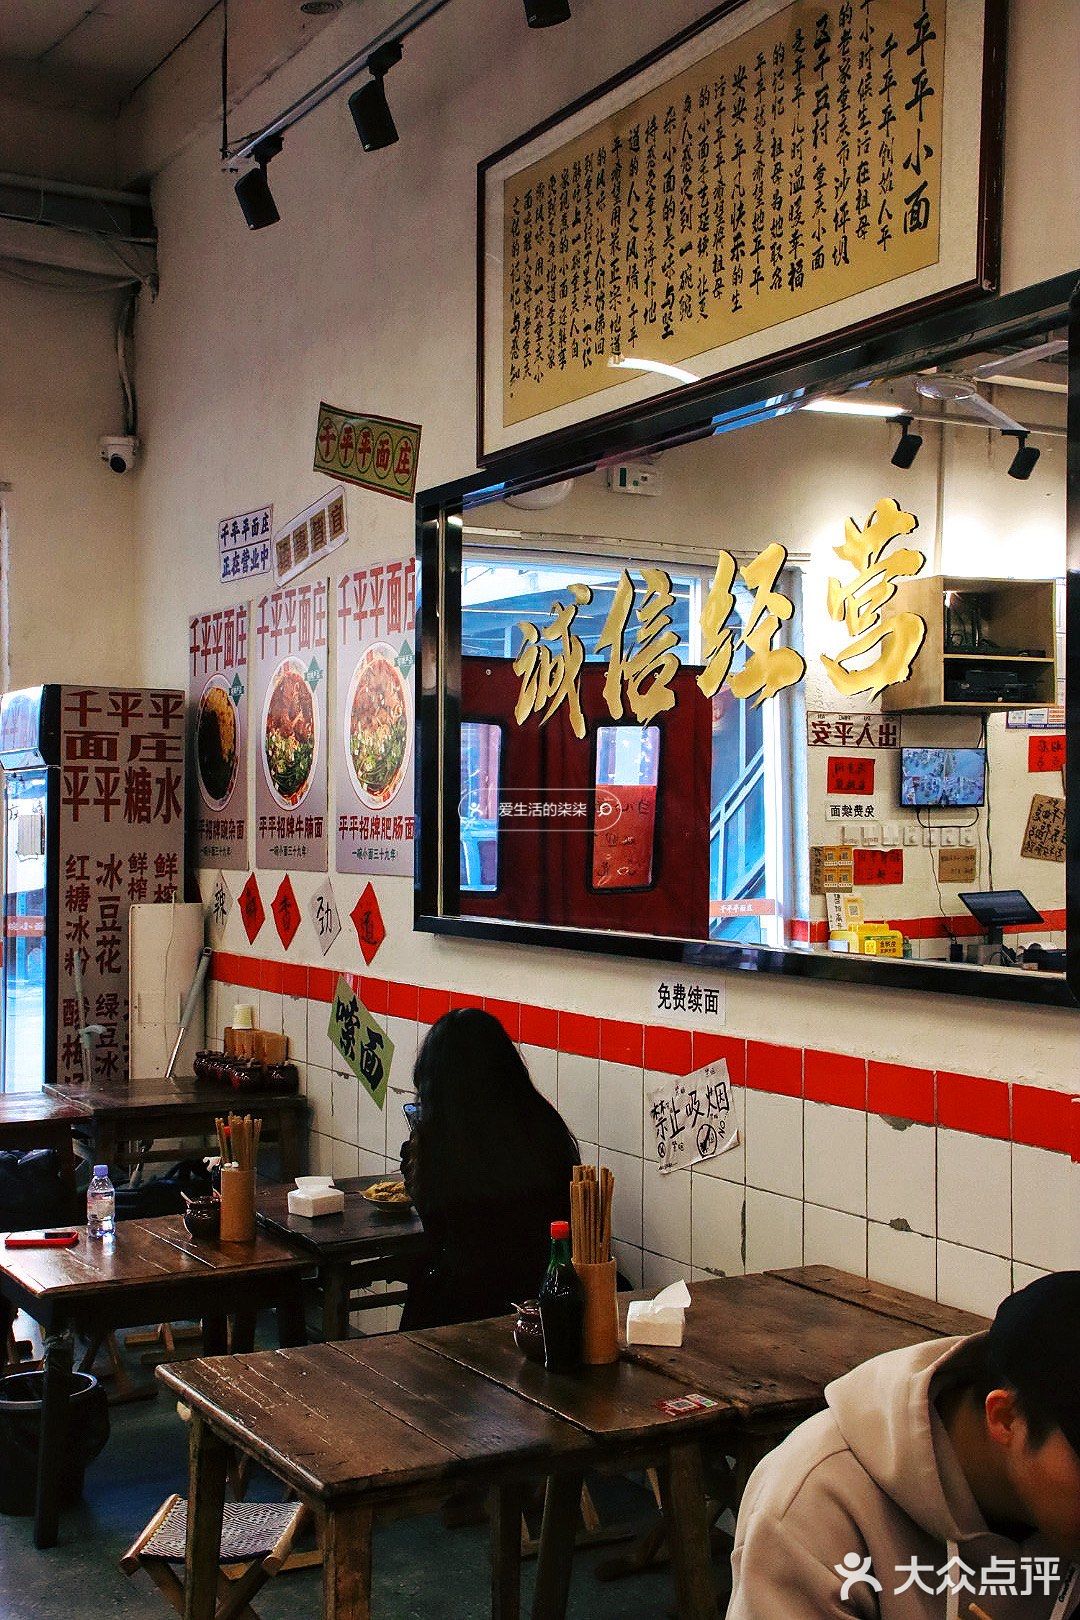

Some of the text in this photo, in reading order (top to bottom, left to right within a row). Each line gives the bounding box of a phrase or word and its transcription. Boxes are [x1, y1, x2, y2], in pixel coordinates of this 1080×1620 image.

[903, 0, 936, 234] 平平小面
[319, 423, 413, 476] 千平平面庄
[220, 511, 270, 547] 千平平面庄
[221, 543, 270, 578] 正在营业中
[190, 605, 248, 677] 千平平面庄
[257, 582, 325, 660] 千平平面庄
[513, 497, 928, 740] 诚信经营
[64, 690, 184, 730] 千平平
[64, 730, 184, 763] 面庄
[61, 765, 183, 825] 平平糖水
[259, 815, 324, 840] 平平招牌牛腩面
[96, 853, 123, 976] 冰豆花
[316, 896, 332, 936] 劲
[657, 982, 720, 1015] 免费续面
[651, 1081, 730, 1141] 禁止吸烟
